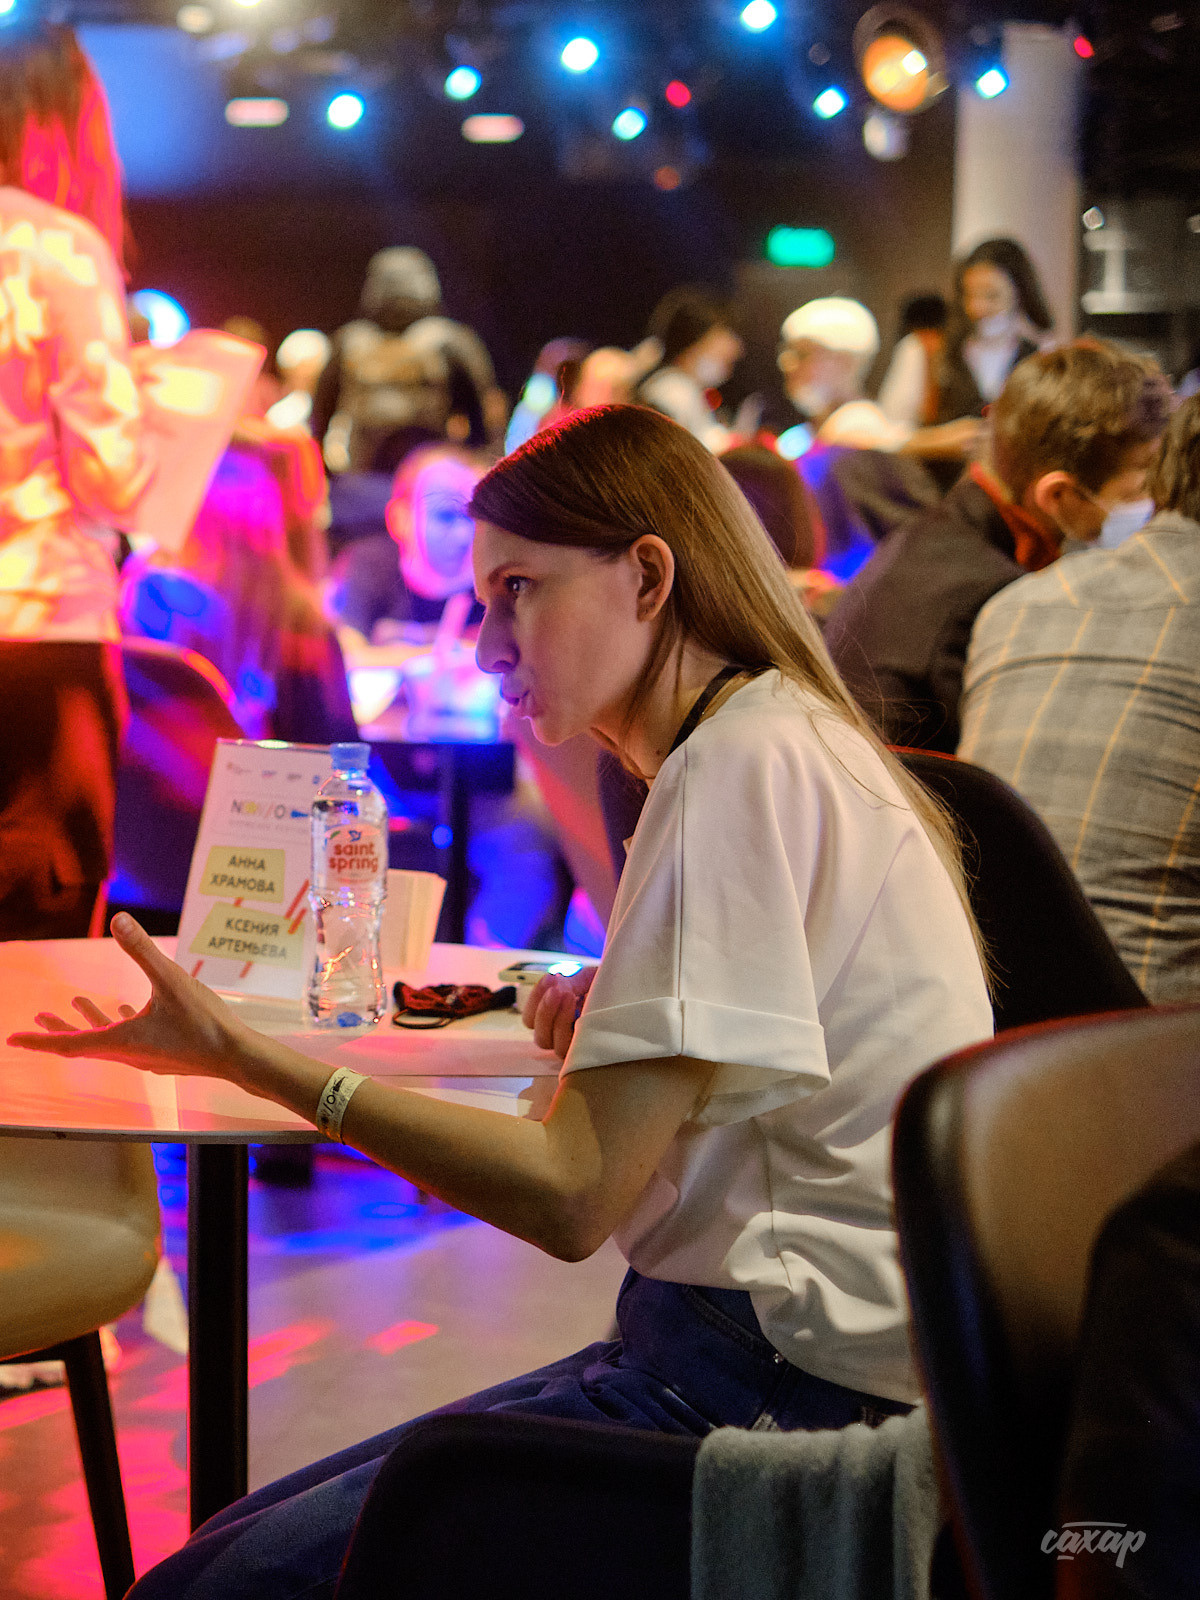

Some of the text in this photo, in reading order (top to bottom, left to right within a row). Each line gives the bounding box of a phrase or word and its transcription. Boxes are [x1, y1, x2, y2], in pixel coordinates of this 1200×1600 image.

[334, 842, 374, 855] saint
[228, 855, 266, 871] АННА
[329, 857, 379, 873] spring
[210, 873, 275, 893] ХРАМОВА
[225, 918, 280, 936] КСЕНИЯ
[208, 936, 287, 959] АРТЕМЬЕВА
